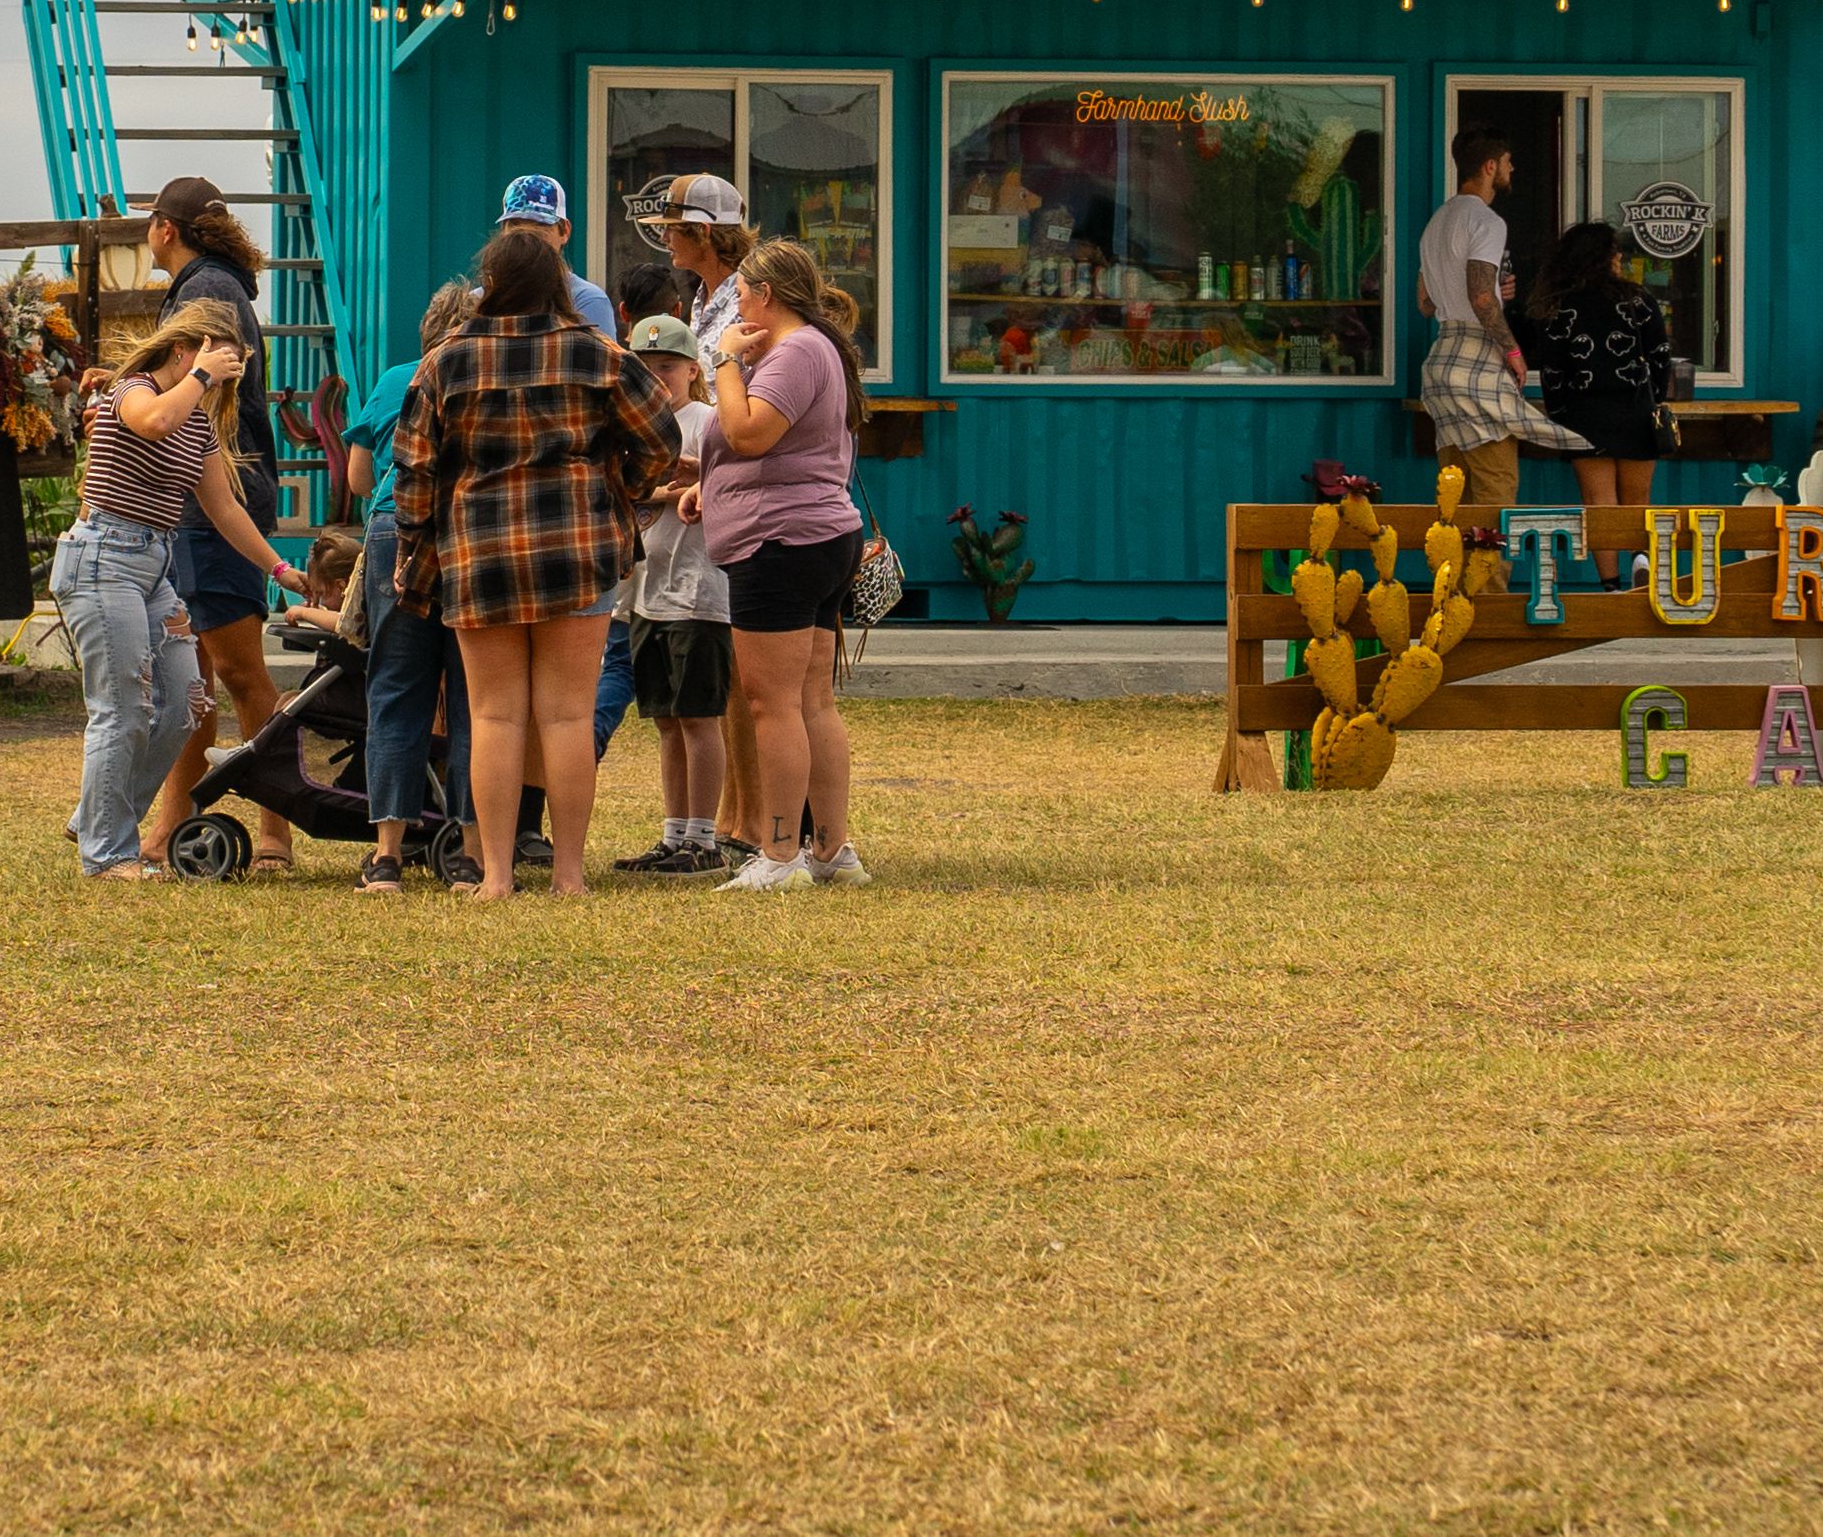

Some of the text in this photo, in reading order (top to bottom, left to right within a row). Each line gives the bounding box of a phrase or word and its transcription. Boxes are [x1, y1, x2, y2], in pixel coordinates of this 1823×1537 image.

[1076, 89, 1250, 124] Farmhand Slush
[1630, 205, 1706, 221] ROCKIN' K
[1651, 224, 1685, 240] FARMS
